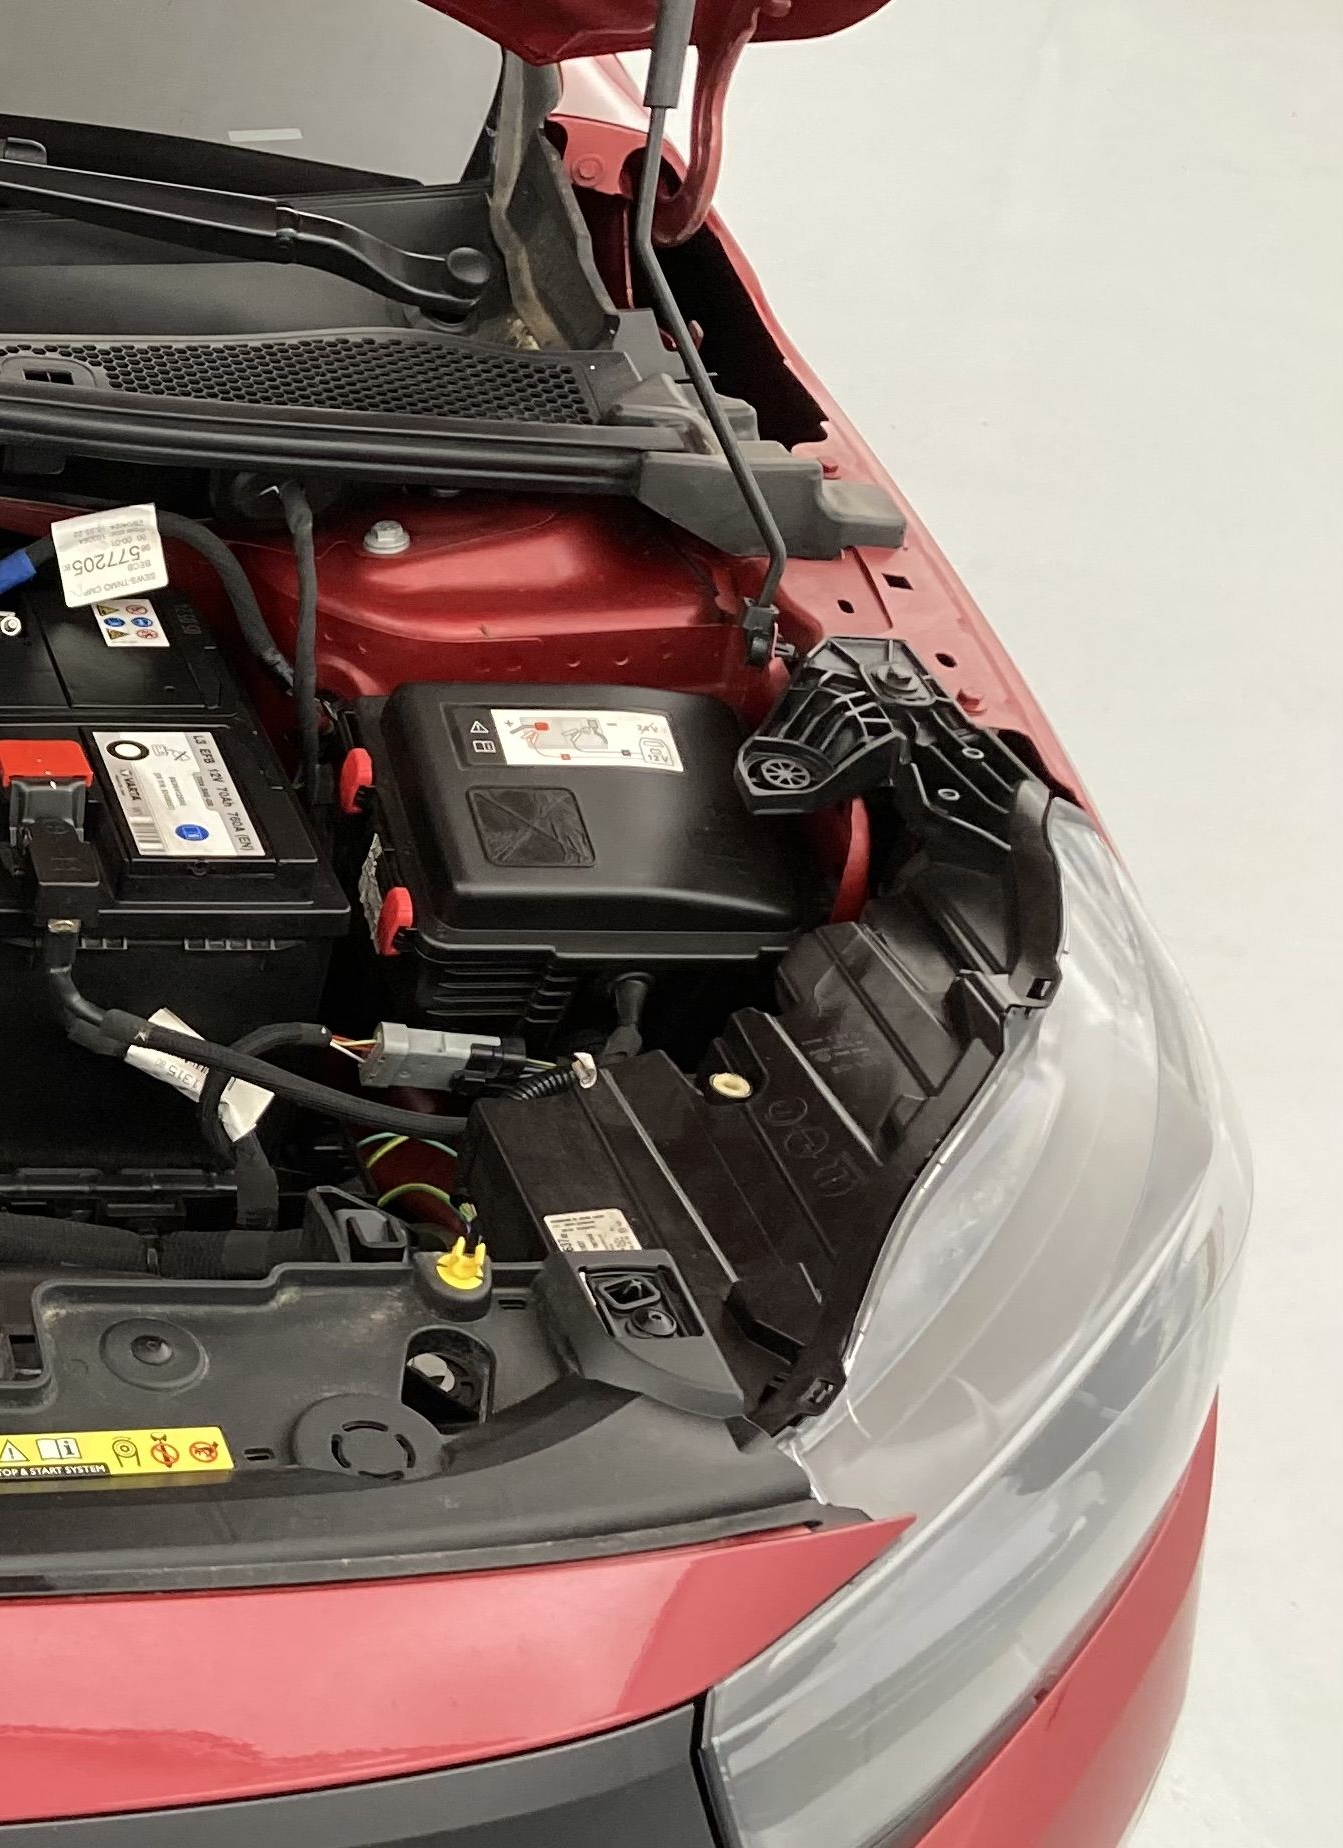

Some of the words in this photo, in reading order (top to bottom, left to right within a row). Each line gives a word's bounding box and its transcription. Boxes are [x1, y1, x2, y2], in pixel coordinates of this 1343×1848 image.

[72, 545, 140, 576] 577205
[198, 748, 216, 763] EFB
[208, 767, 224, 782] 12V
[122, 777, 142, 801] VARTA
[215, 786, 235, 807] 70Ah
[226, 811, 245, 832] 760A
[233, 833, 255, 852] (EN)
[20, 1468, 29, 1477] &
[29, 1466, 63, 1477] START
[64, 1465, 106, 1476] SYSTEM
